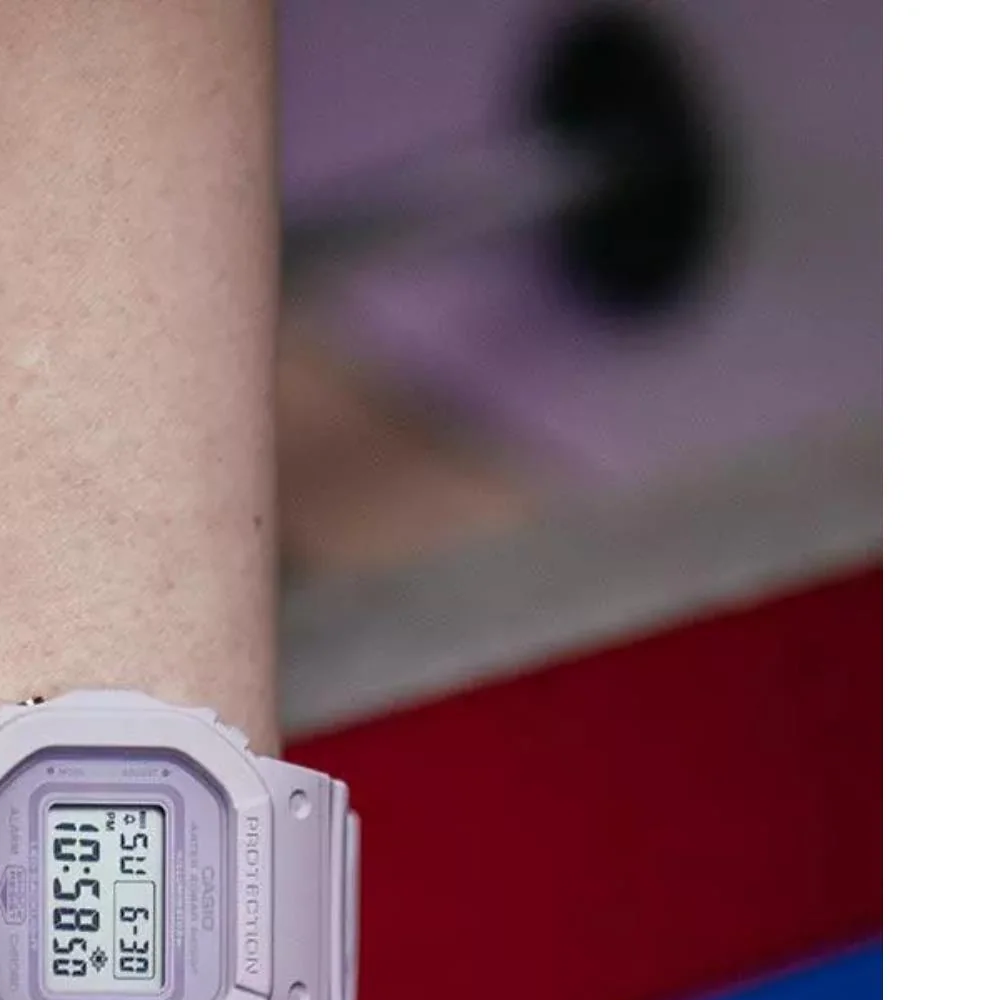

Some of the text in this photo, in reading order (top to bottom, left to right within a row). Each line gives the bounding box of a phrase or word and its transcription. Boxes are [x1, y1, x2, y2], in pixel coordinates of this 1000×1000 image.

[106, 811, 116, 831] PM
[53, 823, 100, 932] 10:58
[201, 866, 215, 932] CASIO
[245, 816, 260, 974] PROTECTION
[53, 938, 87, 976] 50
[120, 906, 149, 973] 6-30
